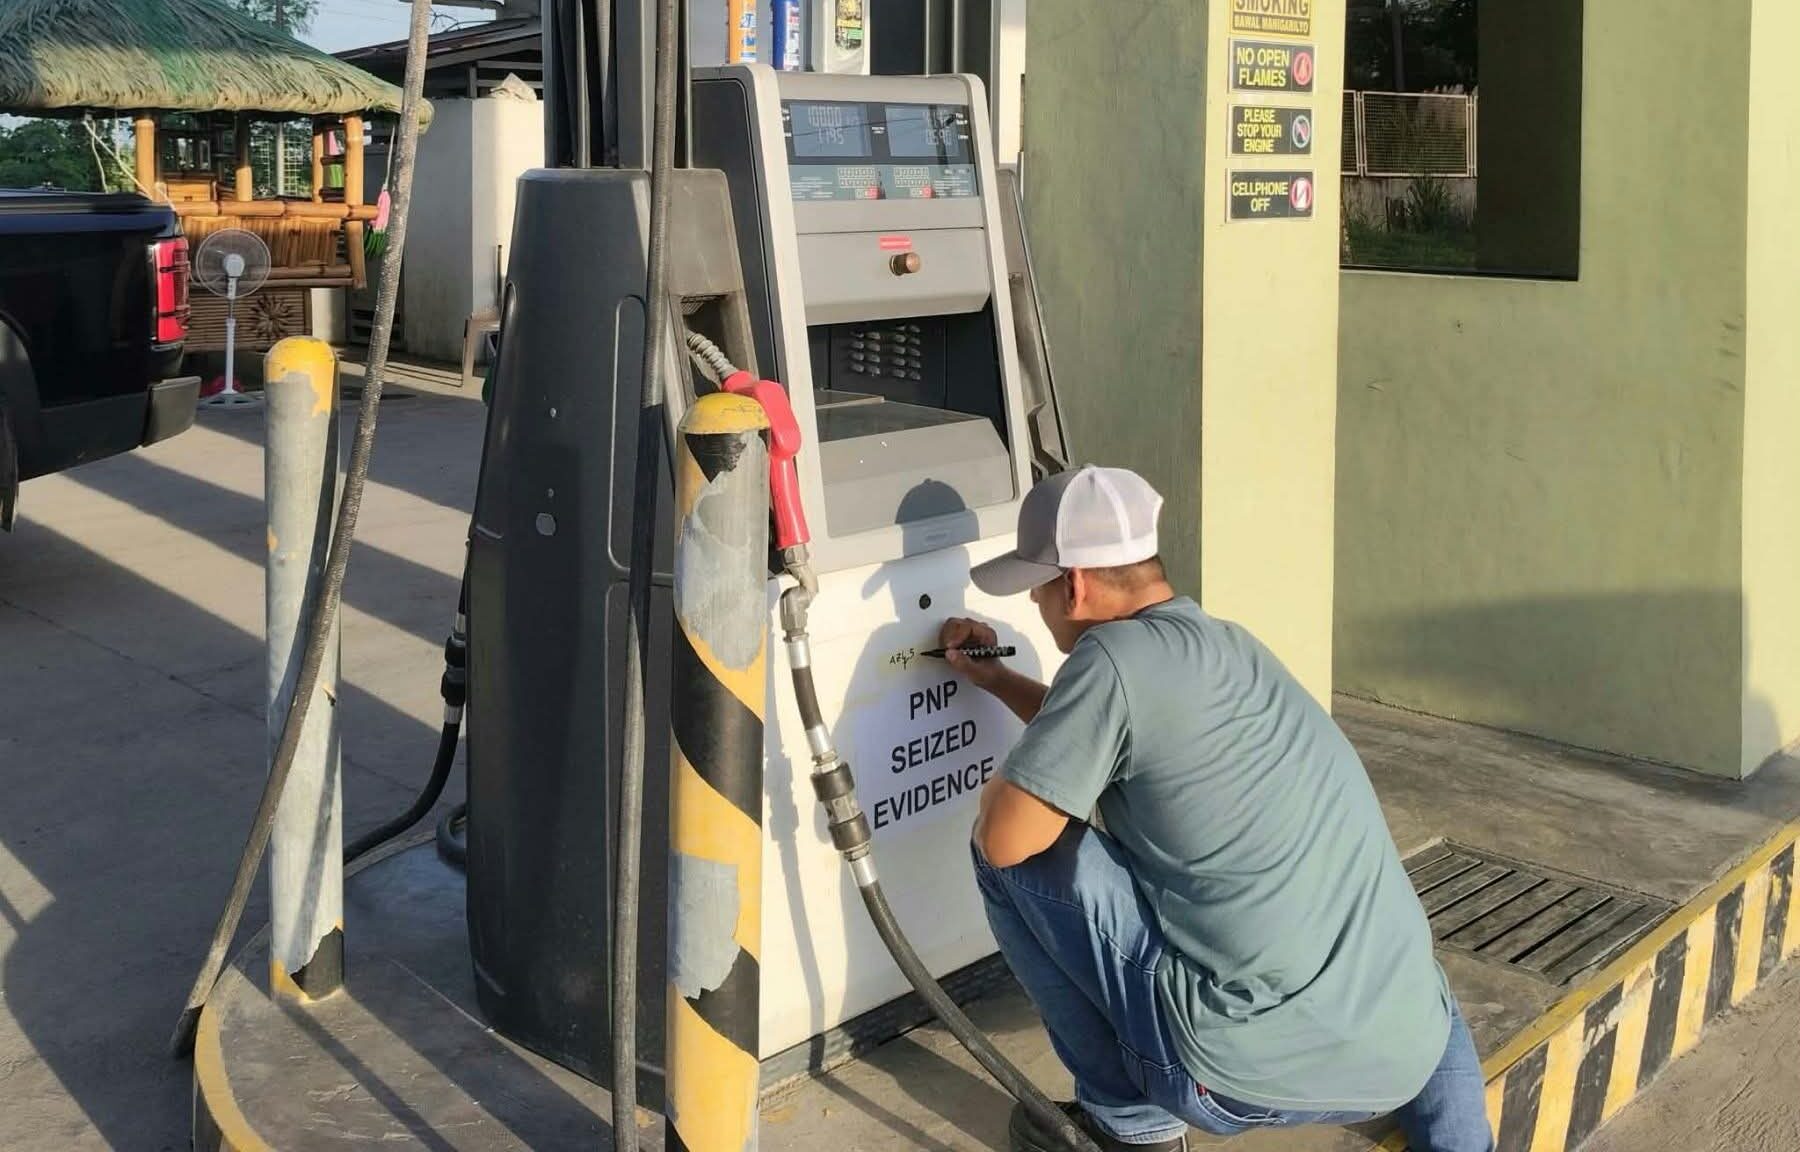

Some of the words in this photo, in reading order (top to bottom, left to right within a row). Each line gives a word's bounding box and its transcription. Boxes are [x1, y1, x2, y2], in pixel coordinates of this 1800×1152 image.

[1236, 47, 1255, 66] NO
[1257, 48, 1290, 67] OPEN
[1238, 68, 1287, 87] FLAMES
[1243, 108, 1275, 123] PLEASE
[1237, 124, 1259, 138] STOP
[1260, 124, 1282, 139] YOUR
[1243, 138, 1275, 153] ENGINE
[1232, 181, 1289, 197] CELLPHONE
[1250, 198, 1271, 213] OFF
[909, 680, 958, 720] PNP
[891, 719, 977, 775] SEIZED
[873, 756, 995, 830] EVIDENCE
